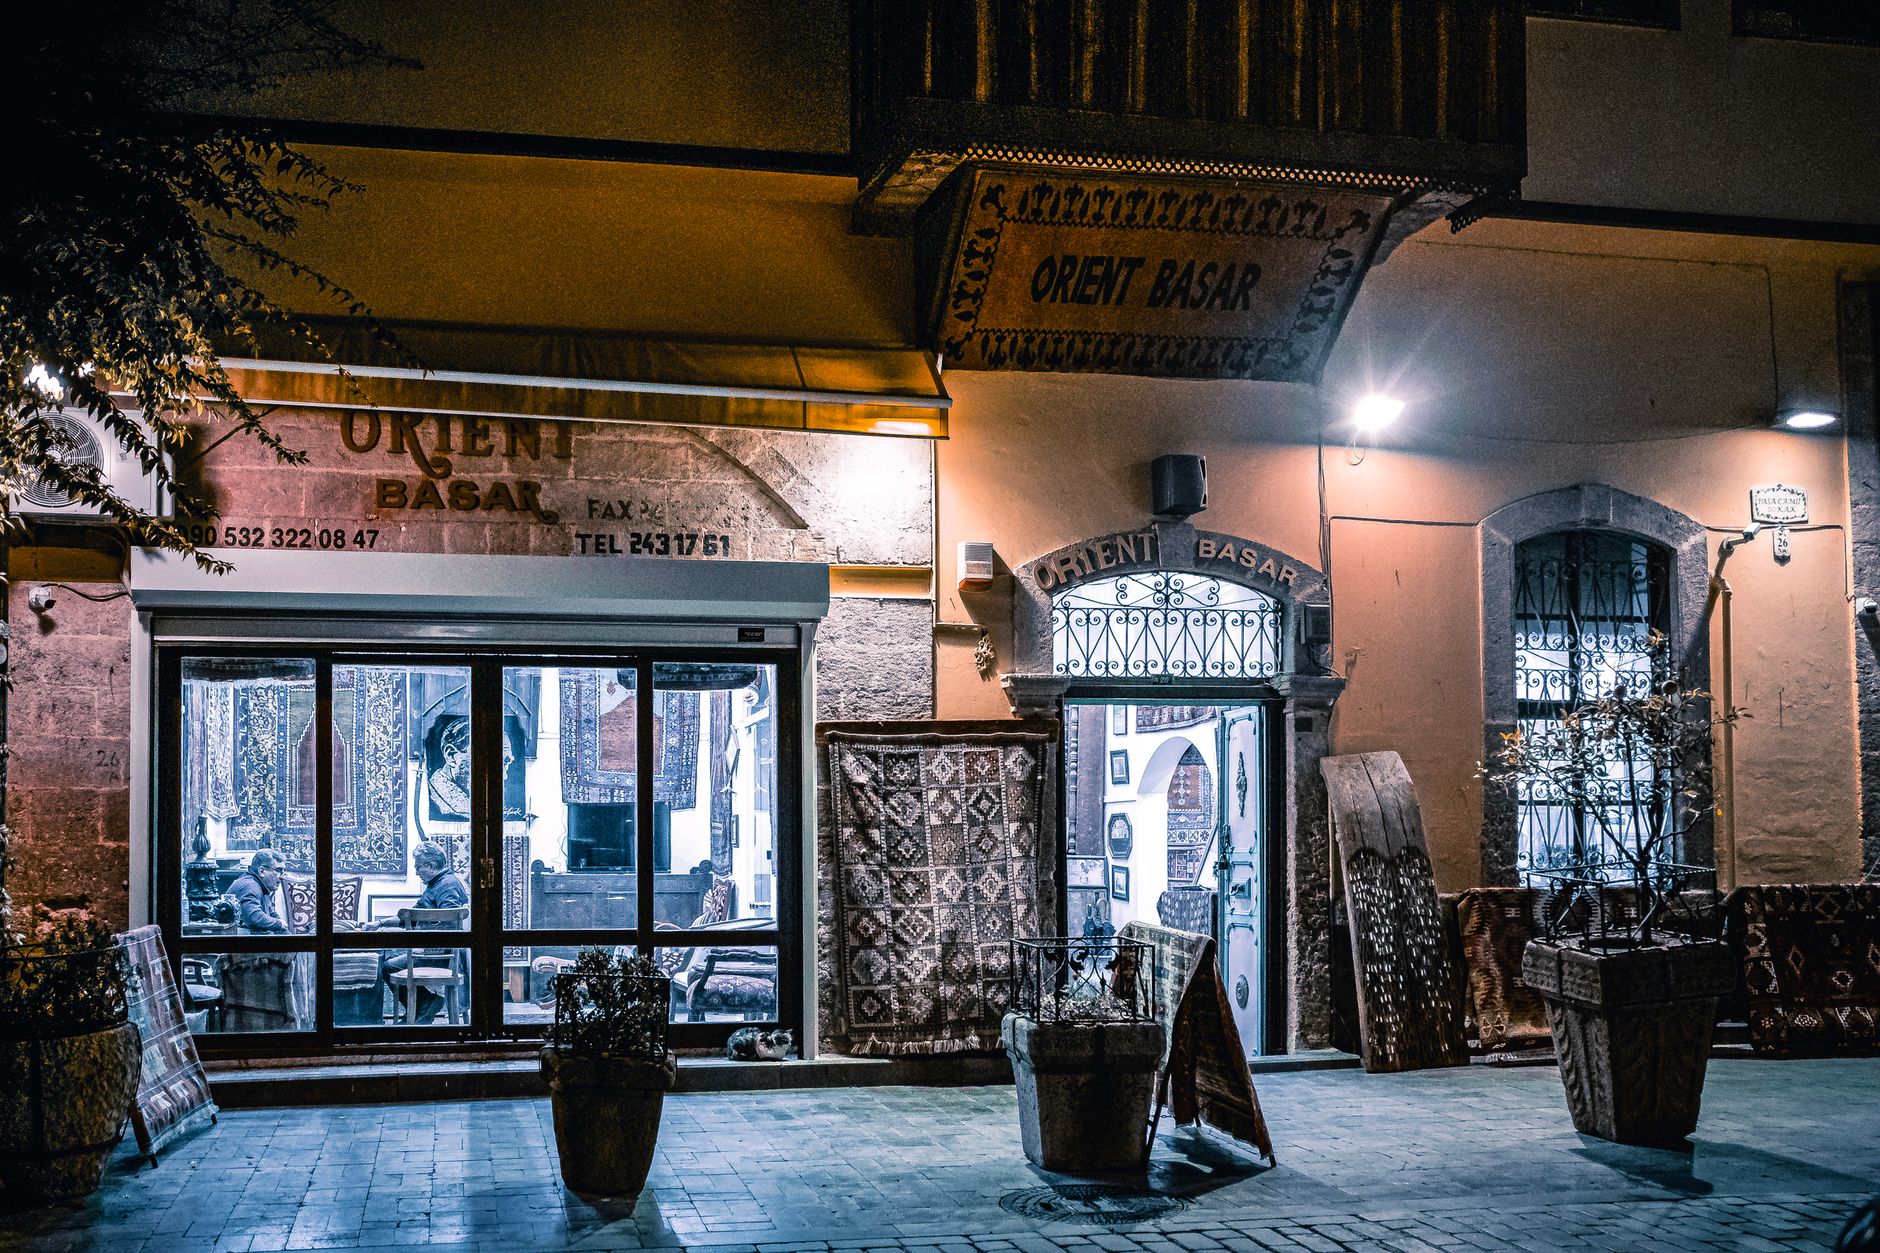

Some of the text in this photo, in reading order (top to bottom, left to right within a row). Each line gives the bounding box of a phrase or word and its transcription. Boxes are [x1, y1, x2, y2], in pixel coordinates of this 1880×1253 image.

[1031, 255, 1262, 311] ORIENT BASAR
[376, 478, 559, 525] BASAR
[587, 498, 634, 520] FAX
[224, 526, 265, 547] 532
[271, 527, 312, 548] 322
[318, 528, 346, 549] 08
[353, 529, 380, 549] 47
[575, 533, 622, 554] TEL
[1778, 537, 1788, 547] 26
[1032, 532, 1298, 590] ORIENT BASAR
